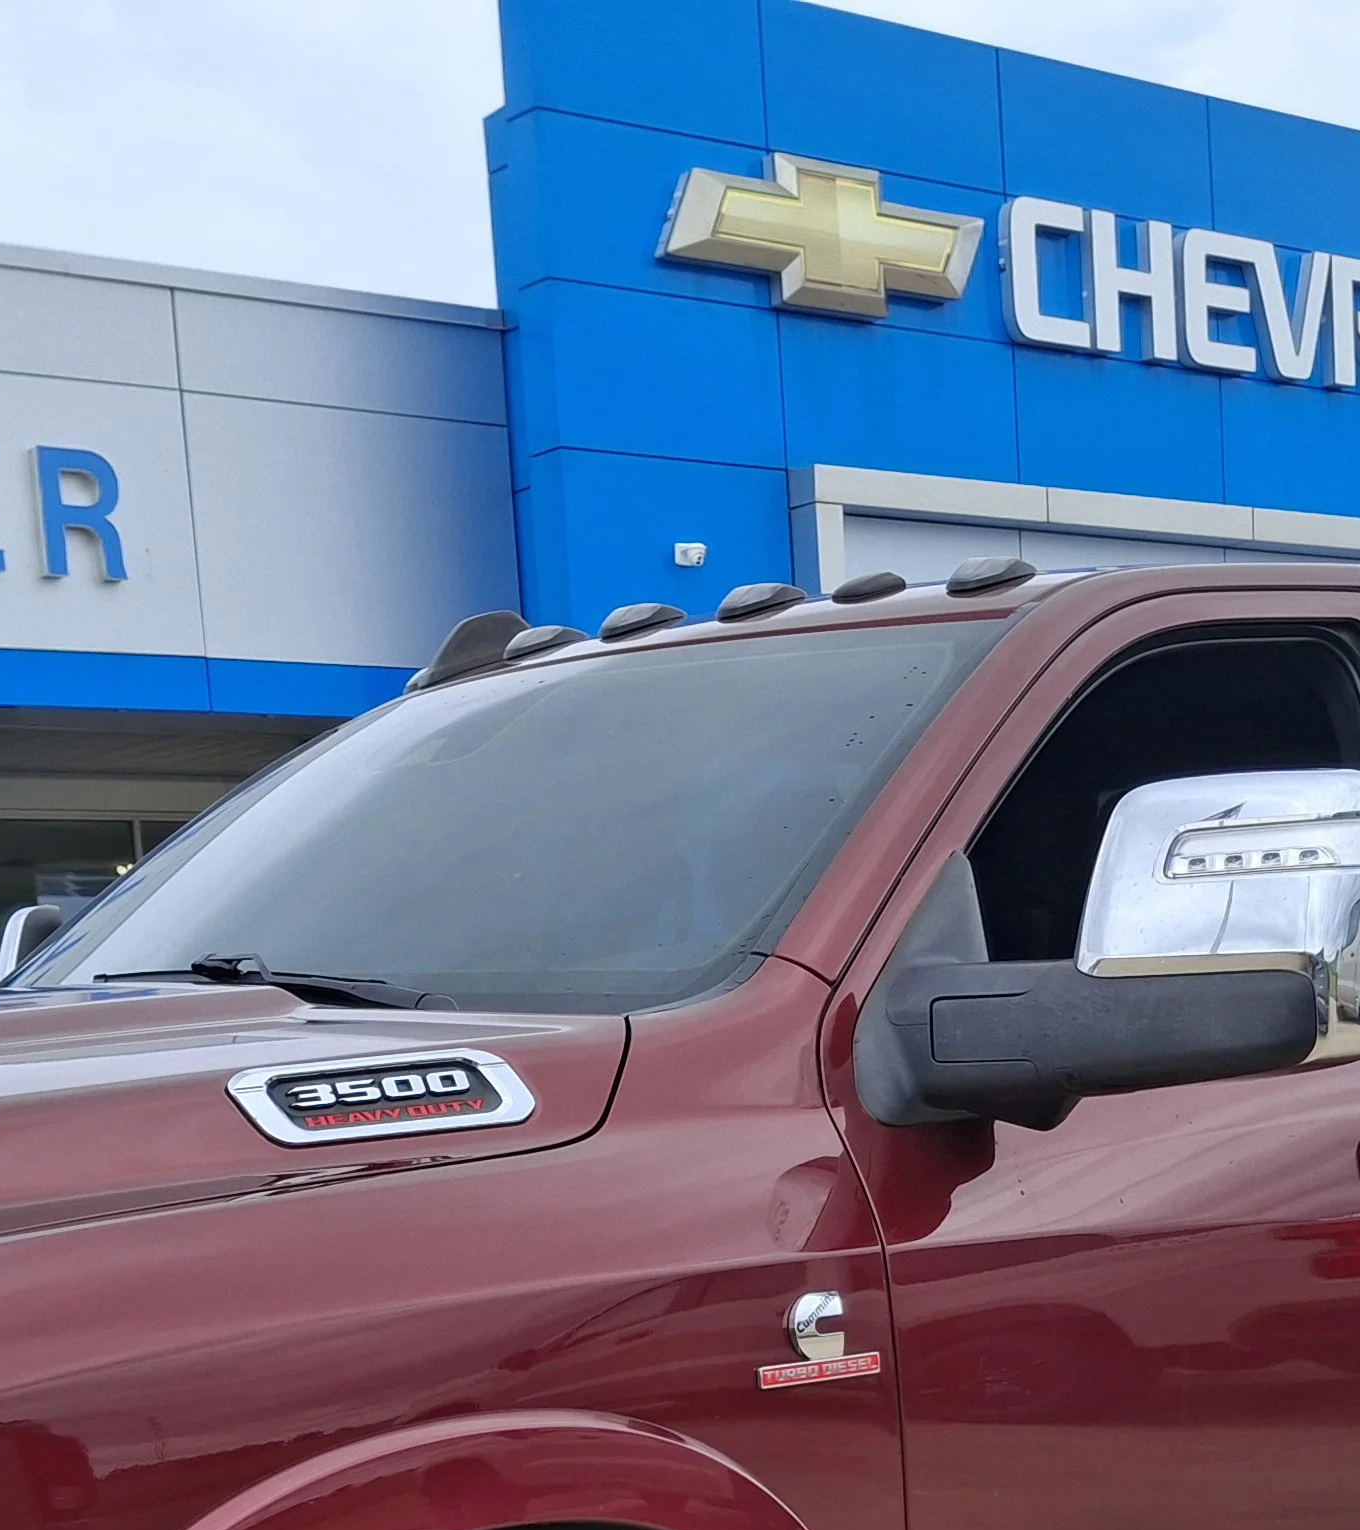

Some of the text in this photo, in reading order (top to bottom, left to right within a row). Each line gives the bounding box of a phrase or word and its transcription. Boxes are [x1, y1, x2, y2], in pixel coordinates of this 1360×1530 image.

[287, 1068, 472, 1109] 3500
[304, 1099, 485, 1128] HEAVY DUTY
[796, 1290, 838, 1334] Cummins
[763, 1356, 878, 1382] TURBO DIESEL
